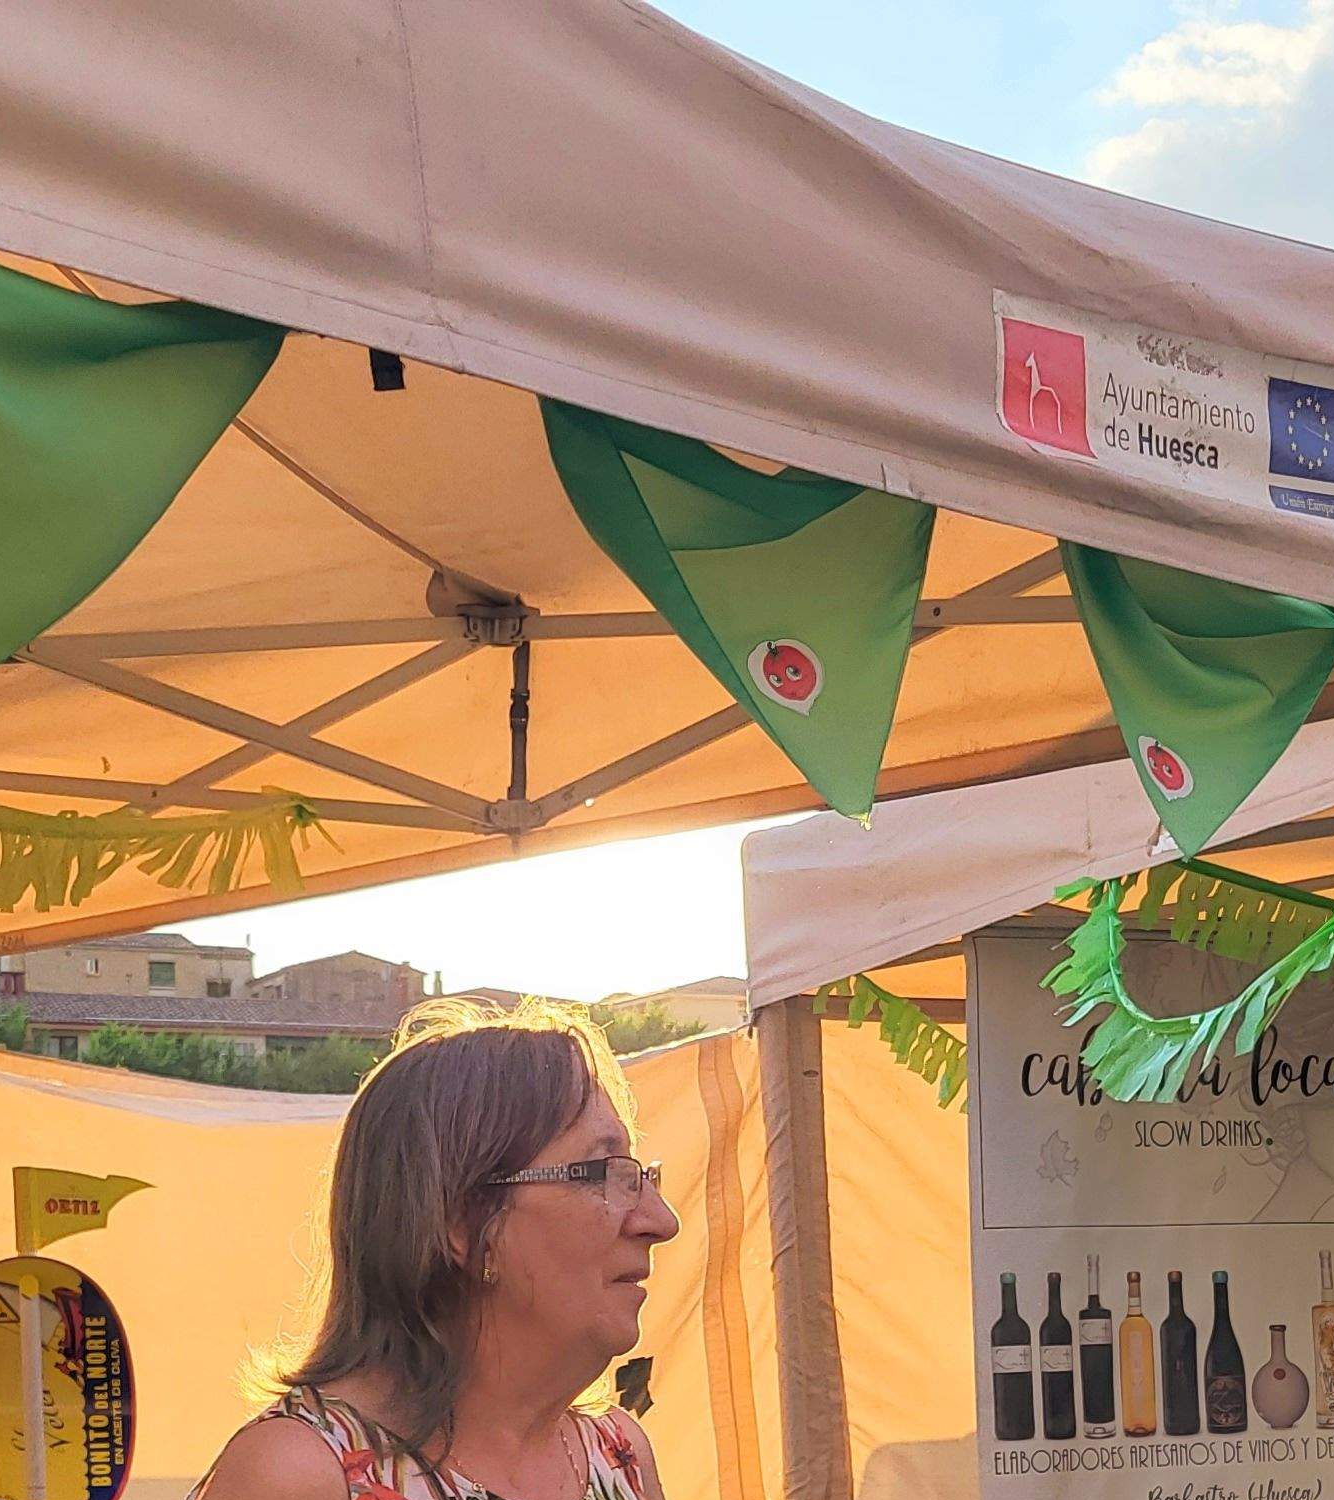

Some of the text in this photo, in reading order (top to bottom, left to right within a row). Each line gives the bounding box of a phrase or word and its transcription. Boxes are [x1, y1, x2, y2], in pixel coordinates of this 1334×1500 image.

[1102, 372, 1255, 434] Ayuntamiento
[1104, 417, 1219, 470] de Huesca
[1134, 1119, 1192, 1148] SLOW
[44, 1198, 100, 1216] ORTIZ
[85, 1315, 112, 1487] BONITO DEL NORTE
[110, 1339, 124, 1465] EN ACEITE DE OLIVA
[994, 1446, 1124, 1476] ELABORADORES
[1129, 1442, 1217, 1469] ARTESANOS
[1224, 1441, 1243, 1464] DE
[1248, 1438, 1296, 1463] VINOS
[1300, 1437, 1310, 1460] Y
